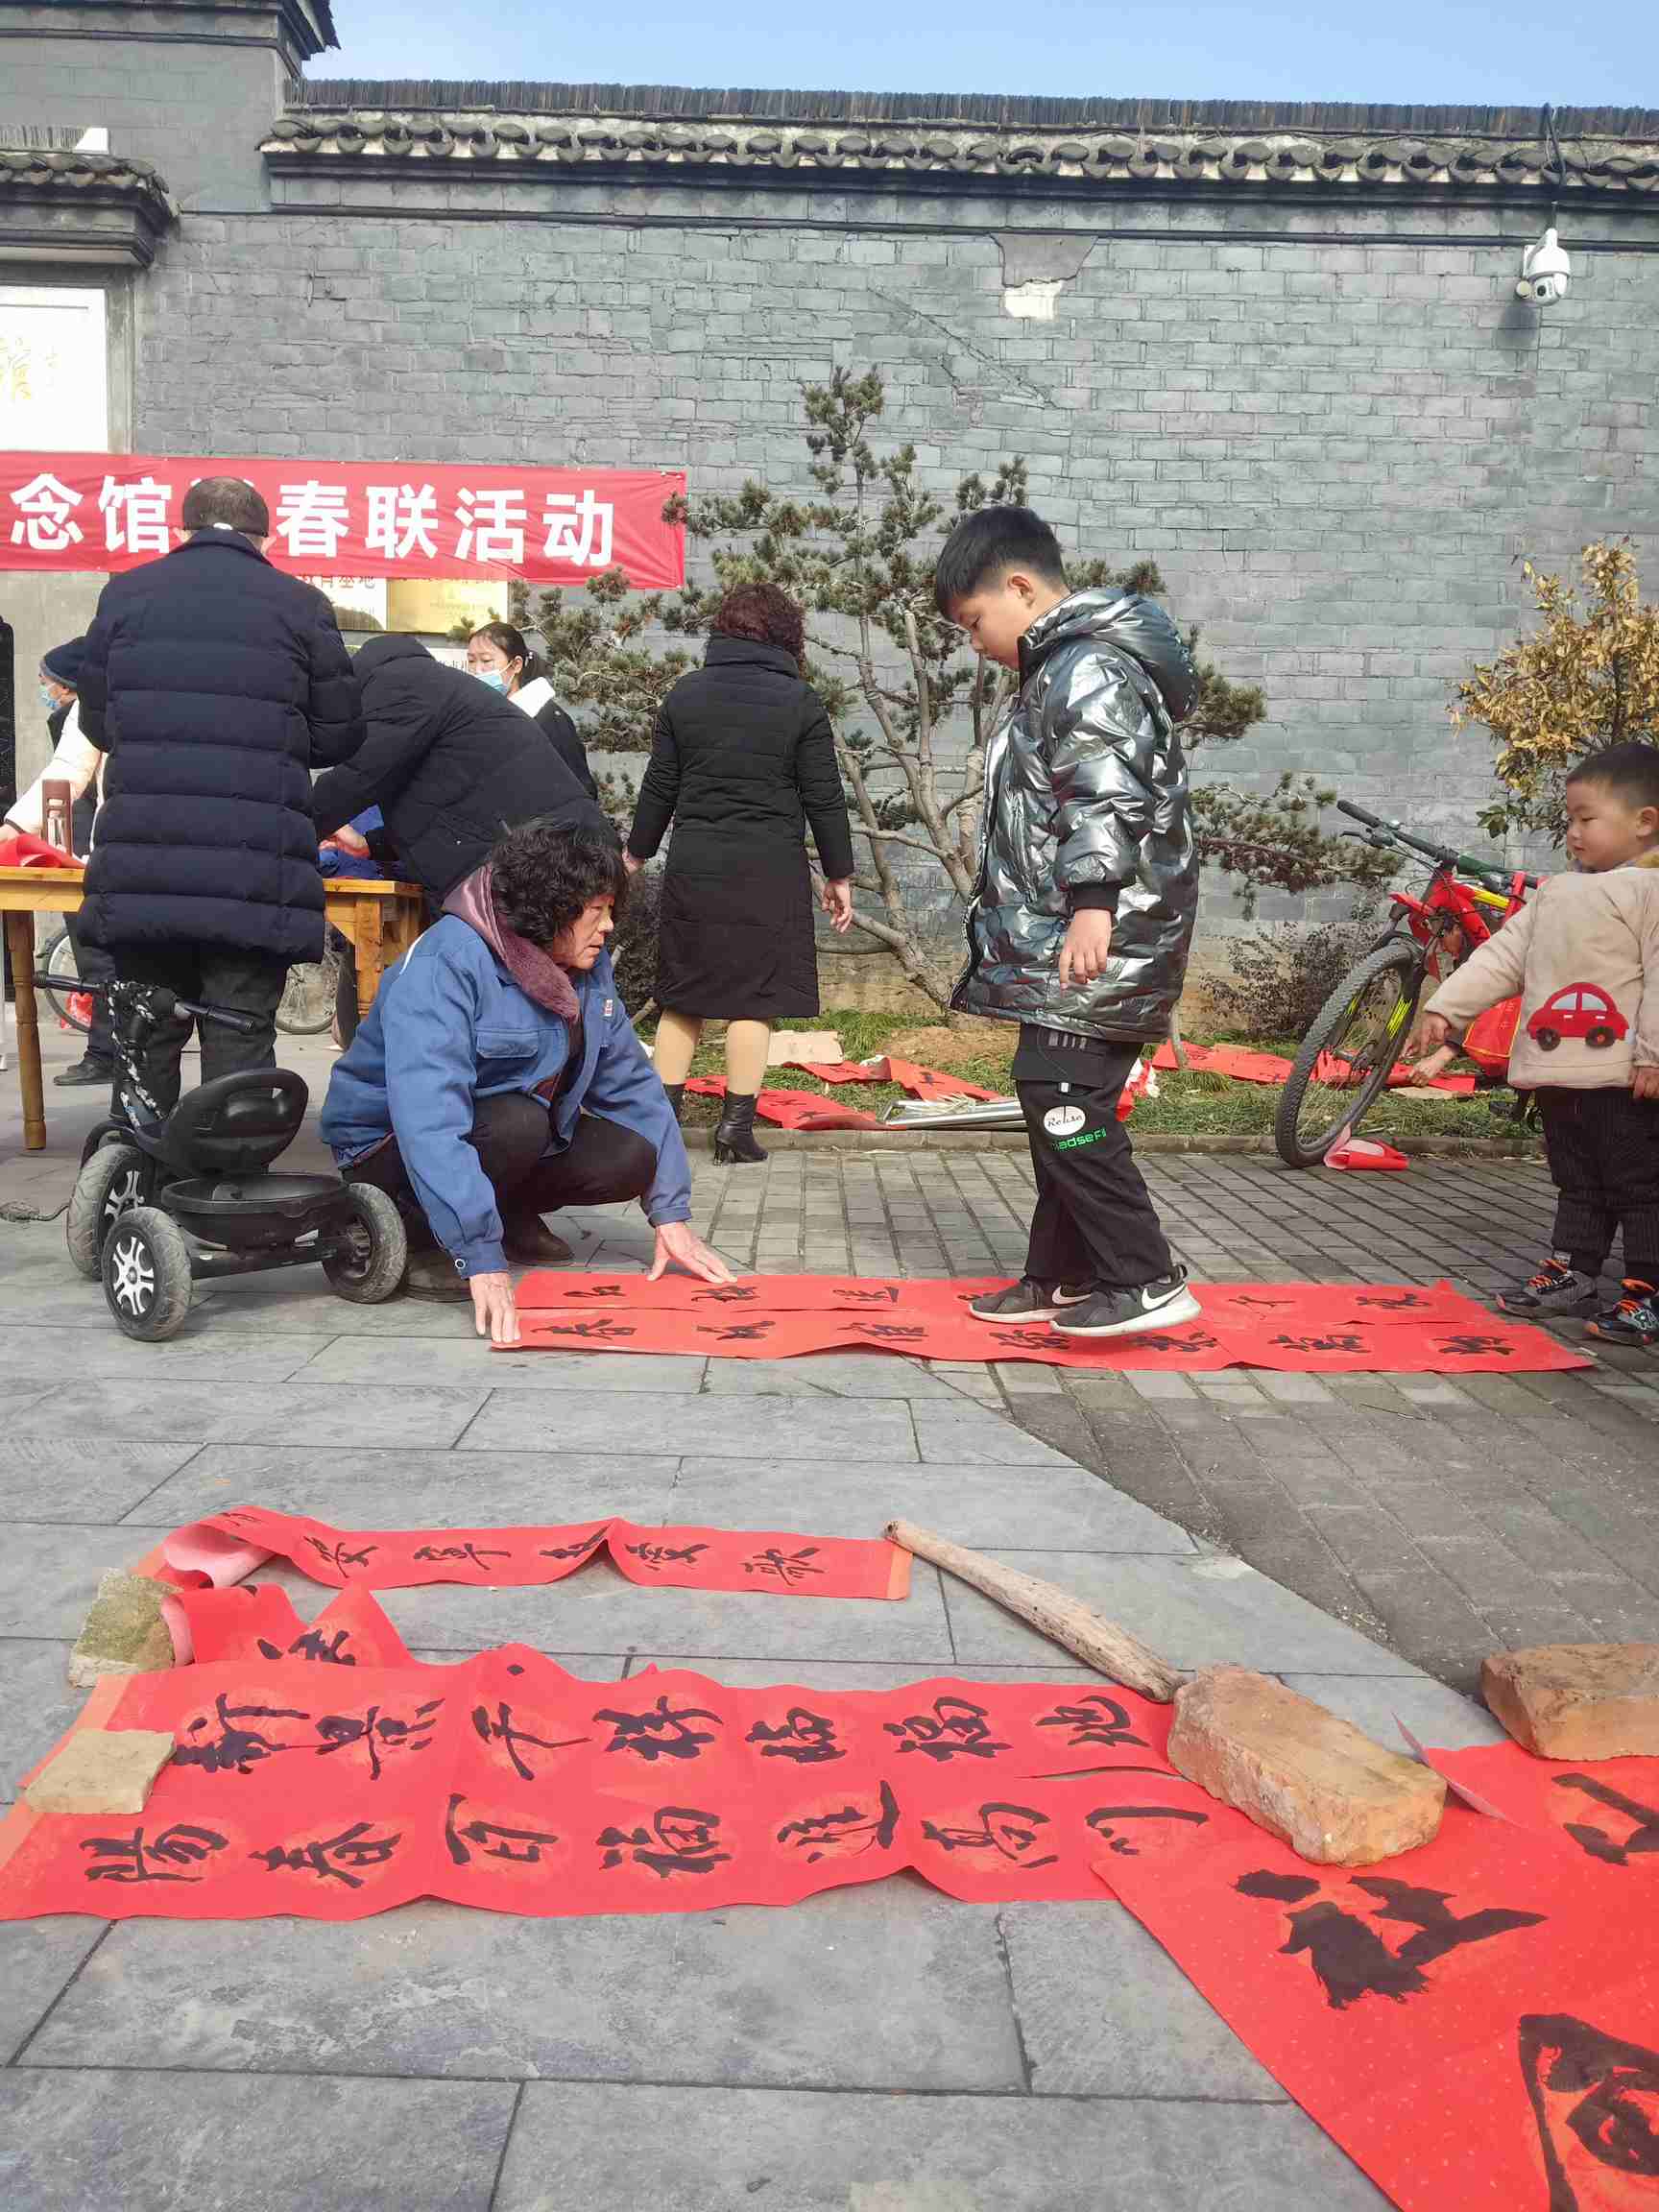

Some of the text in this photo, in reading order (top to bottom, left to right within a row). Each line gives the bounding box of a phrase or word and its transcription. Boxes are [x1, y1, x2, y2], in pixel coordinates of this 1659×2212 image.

[9, 471, 614, 567] 念馆春联活动
